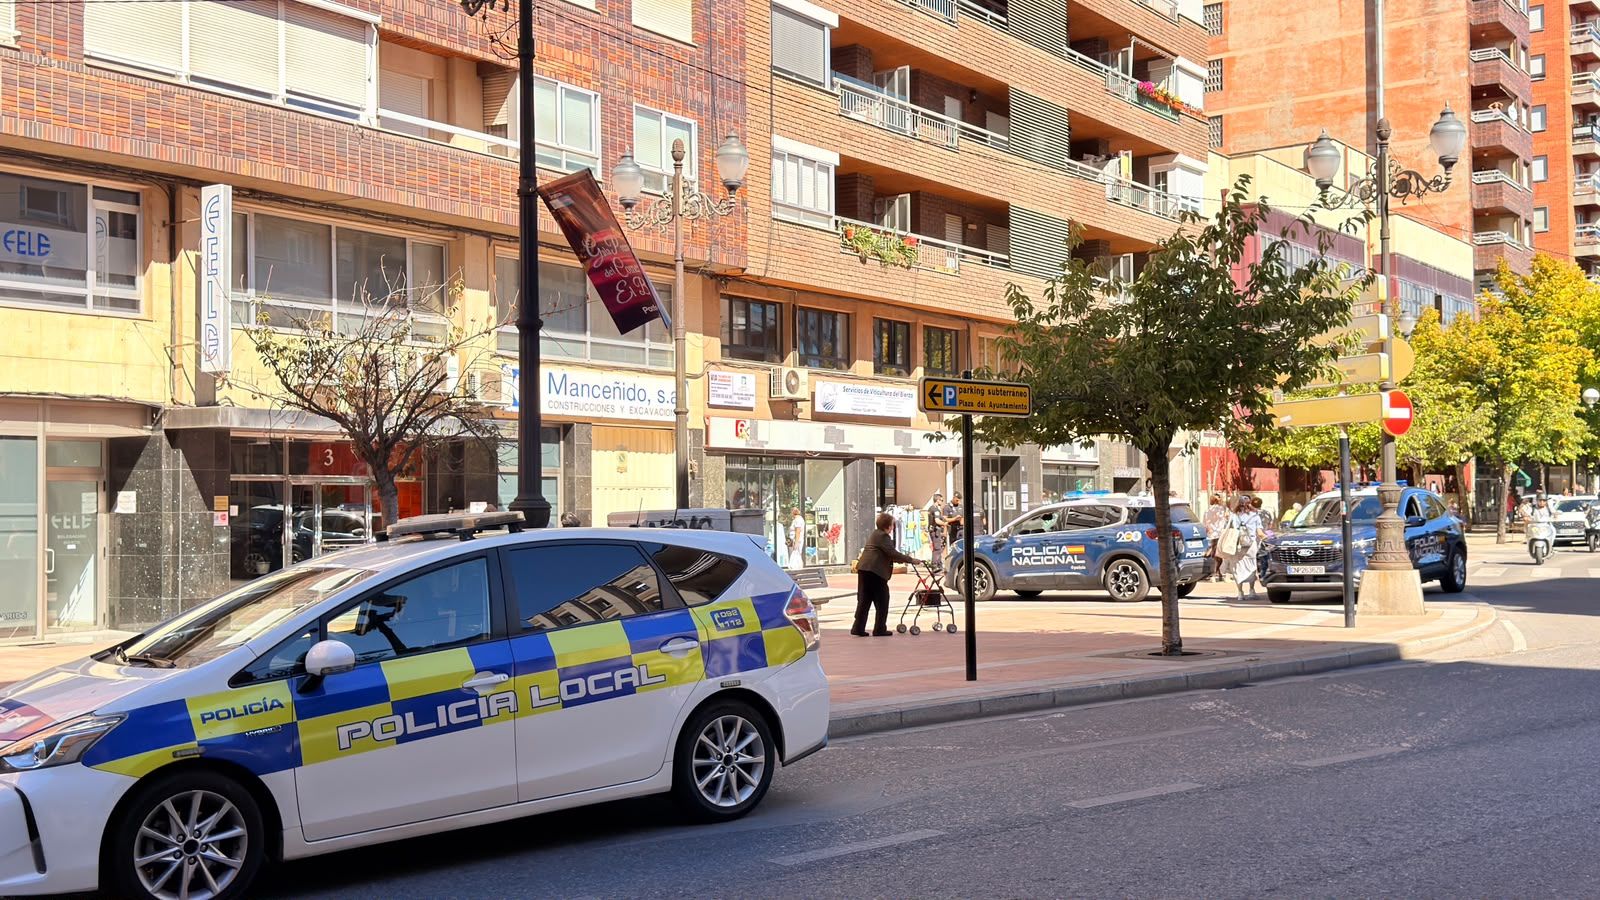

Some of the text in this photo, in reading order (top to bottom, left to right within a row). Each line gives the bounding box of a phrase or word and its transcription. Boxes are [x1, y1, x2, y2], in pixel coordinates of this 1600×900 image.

[4, 230, 51, 256] FELE
[205, 194, 220, 362] FELE
[548, 372, 651, 405] Manceñido,
[945, 387, 955, 404] P
[958, 386, 984, 396] parking
[548, 400, 676, 417] CONSTRUCCIONES Y EXCAVACION
[958, 399, 973, 407] Plaza
[989, 401, 1027, 410] Ayuntamiento
[324, 449, 334, 466] 3
[1012, 545, 1069, 556] POLICIA
[1012, 555, 1086, 566] NACIONAL
[720, 609, 738, 618] 092
[200, 697, 285, 724] POLICÍA
[336, 664, 666, 750] POLICIA LOCAL
